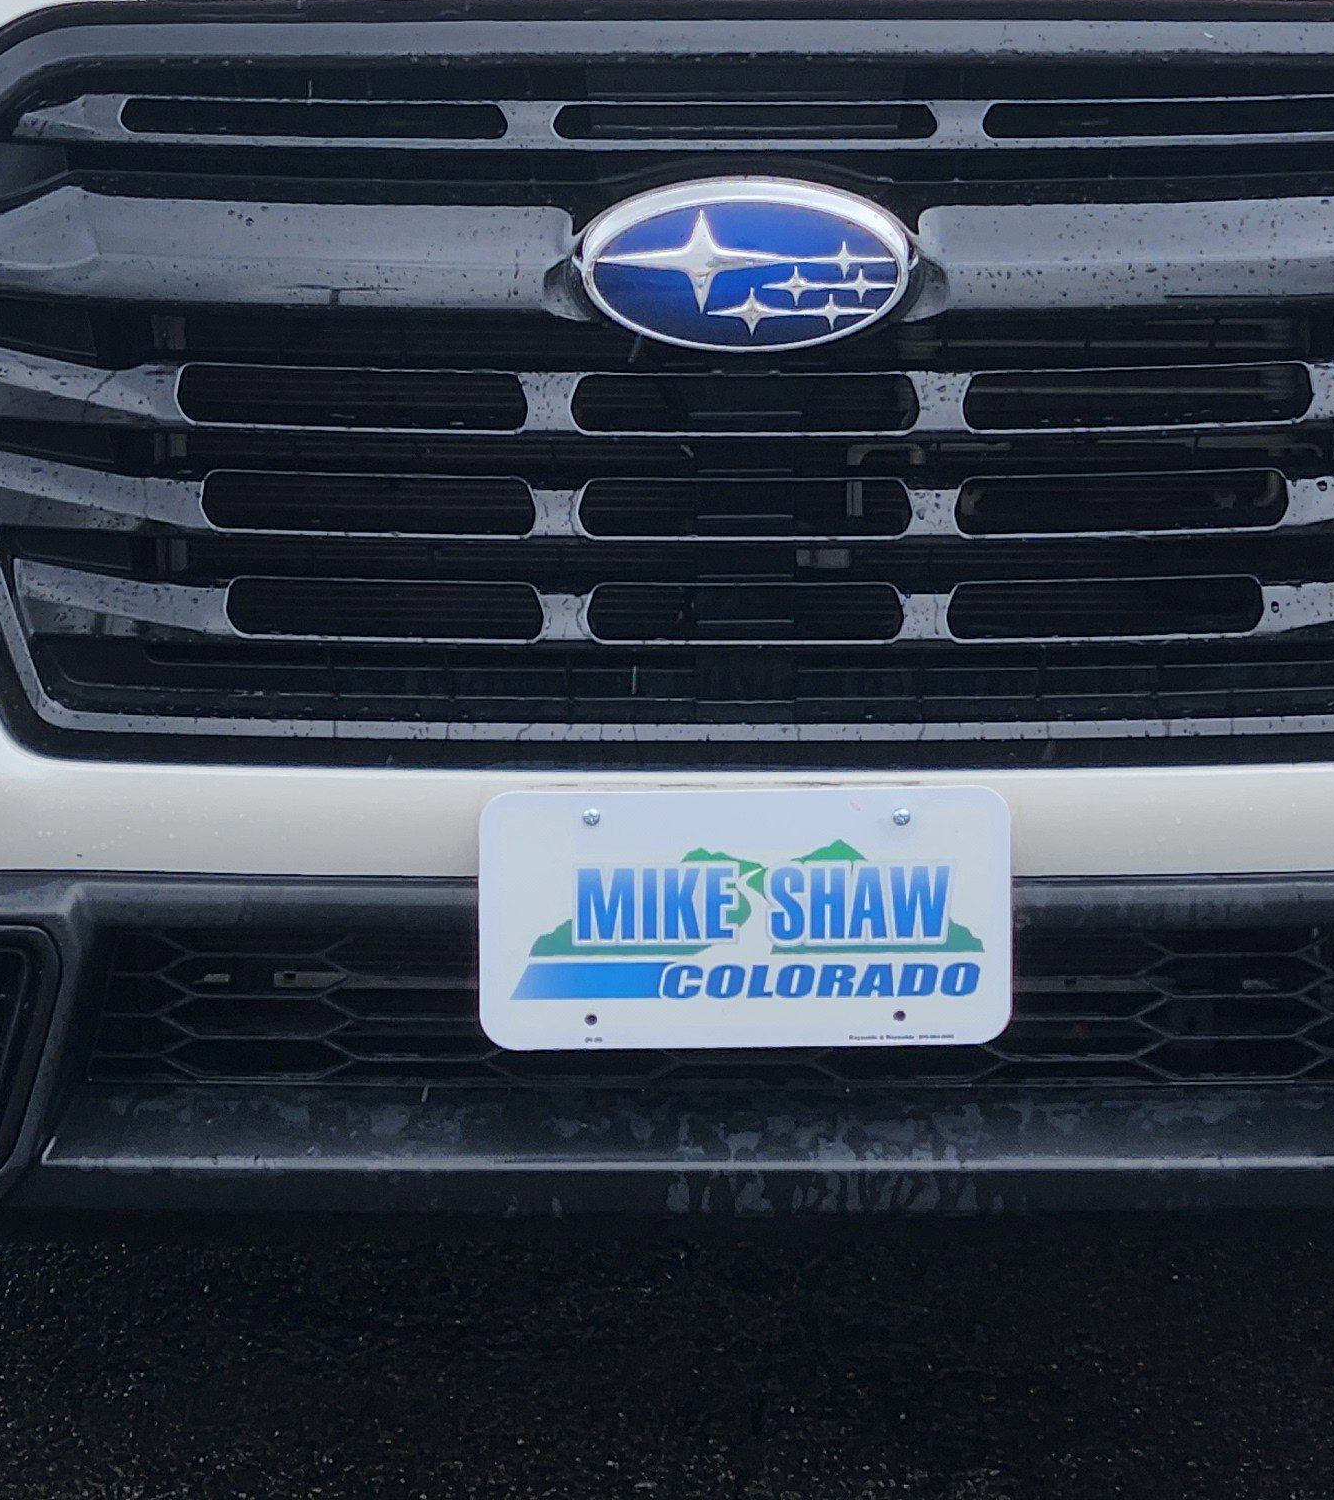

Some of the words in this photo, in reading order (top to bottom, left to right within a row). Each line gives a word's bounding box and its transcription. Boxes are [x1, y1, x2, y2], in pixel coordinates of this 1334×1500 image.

[575, 864, 737, 943] MIKE
[768, 862, 951, 946] SHAW
[661, 960, 982, 1000] COLORADO
